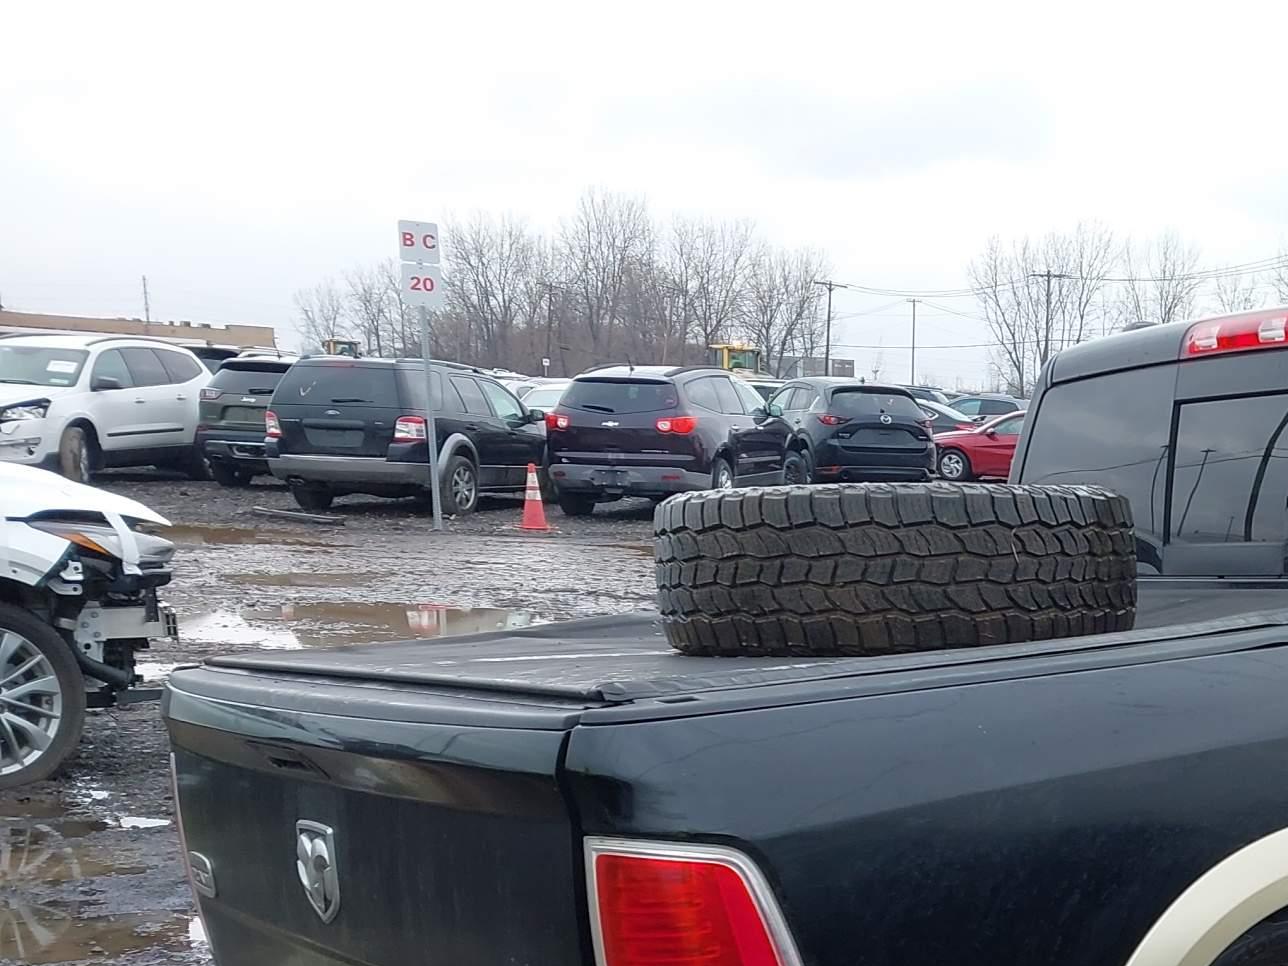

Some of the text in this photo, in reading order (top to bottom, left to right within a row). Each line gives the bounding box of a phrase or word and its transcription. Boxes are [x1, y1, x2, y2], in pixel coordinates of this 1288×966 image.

[402, 231, 437, 249] B C
[410, 276, 435, 292] 20
